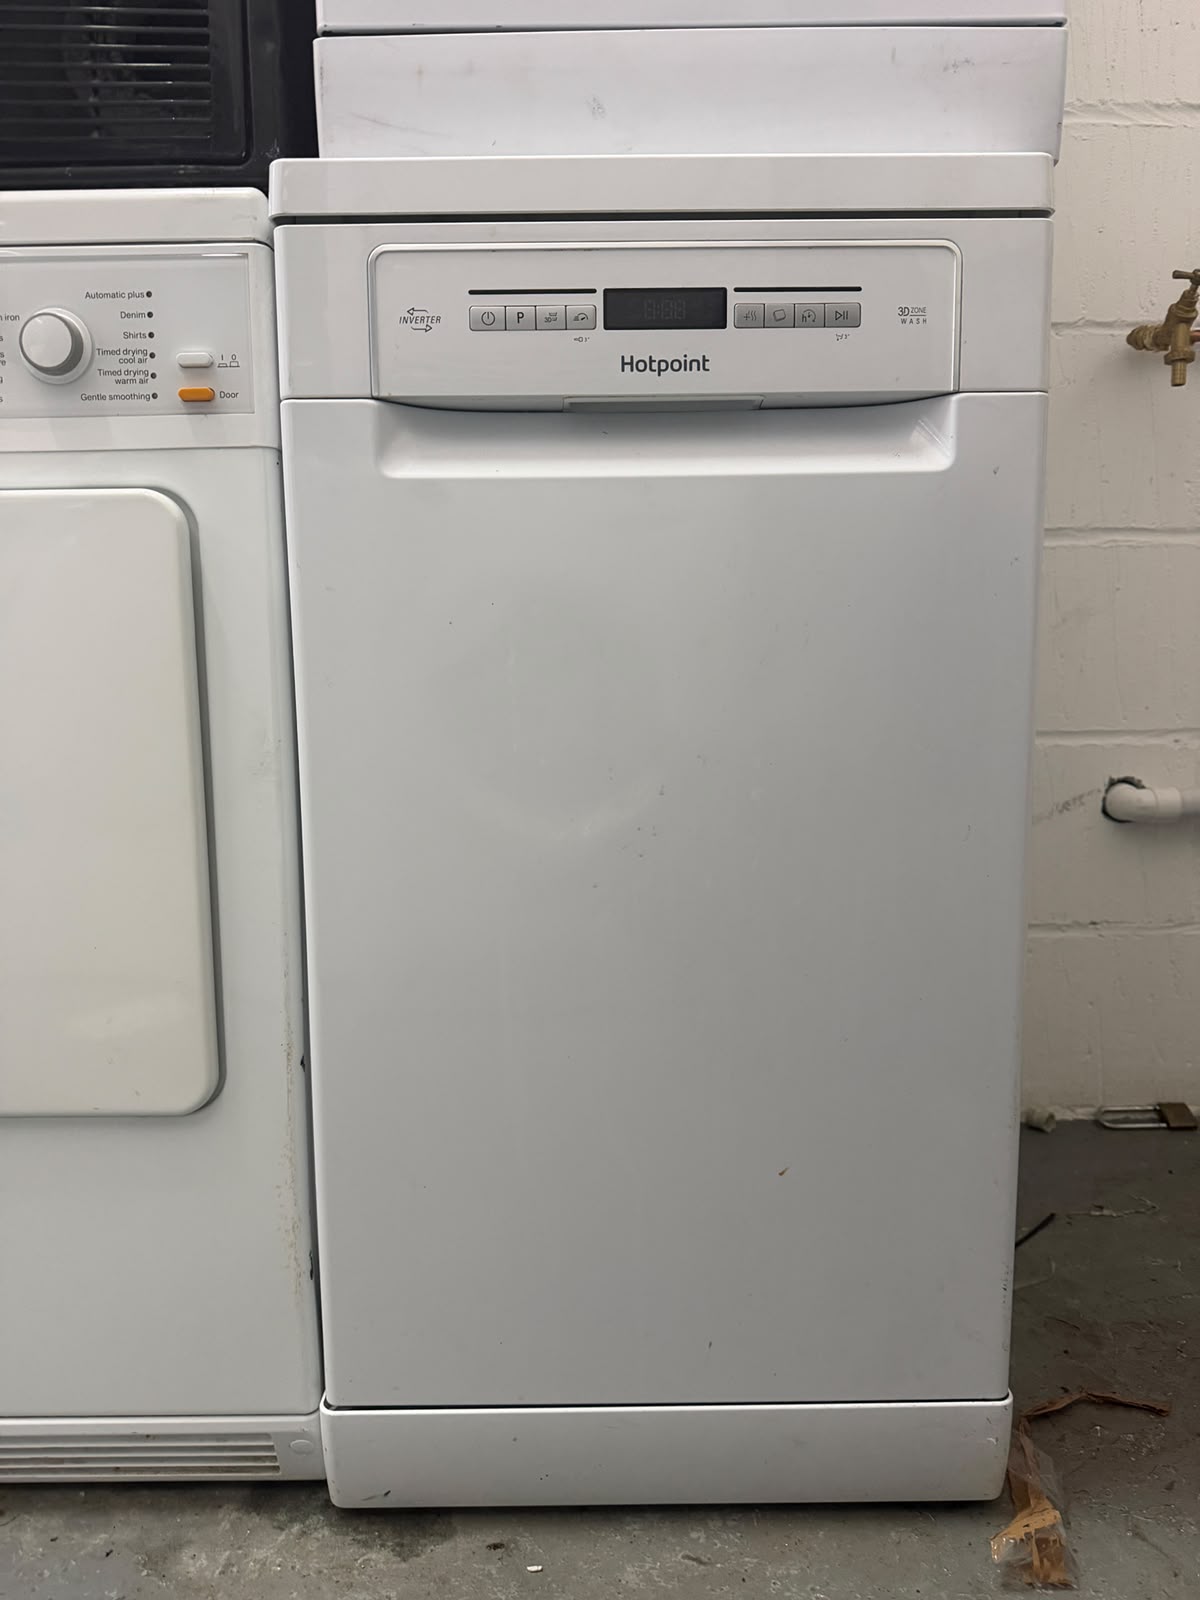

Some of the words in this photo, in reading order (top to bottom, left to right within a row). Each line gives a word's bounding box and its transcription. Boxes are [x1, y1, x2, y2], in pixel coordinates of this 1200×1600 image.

[84, 291, 126, 299] Automatic
[128, 291, 145, 300] plus
[4, 312, 20, 321] iron
[120, 311, 146, 319] Denim
[399, 315, 442, 325] INVERTER
[123, 331, 147, 340] Shirts
[96, 348, 121, 356] Timed
[122, 348, 148, 358] drying
[118, 356, 135, 364] cool
[136, 356, 147, 364] air
[620, 354, 710, 377] Hotpoint
[97, 369, 122, 377] Timed
[123, 368, 149, 378] drying
[115, 377, 136, 385] warm
[138, 377, 149, 385] air
[80, 393, 107, 401] Gentle
[108, 392, 151, 403] smoothing
[219, 390, 239, 399] Door
